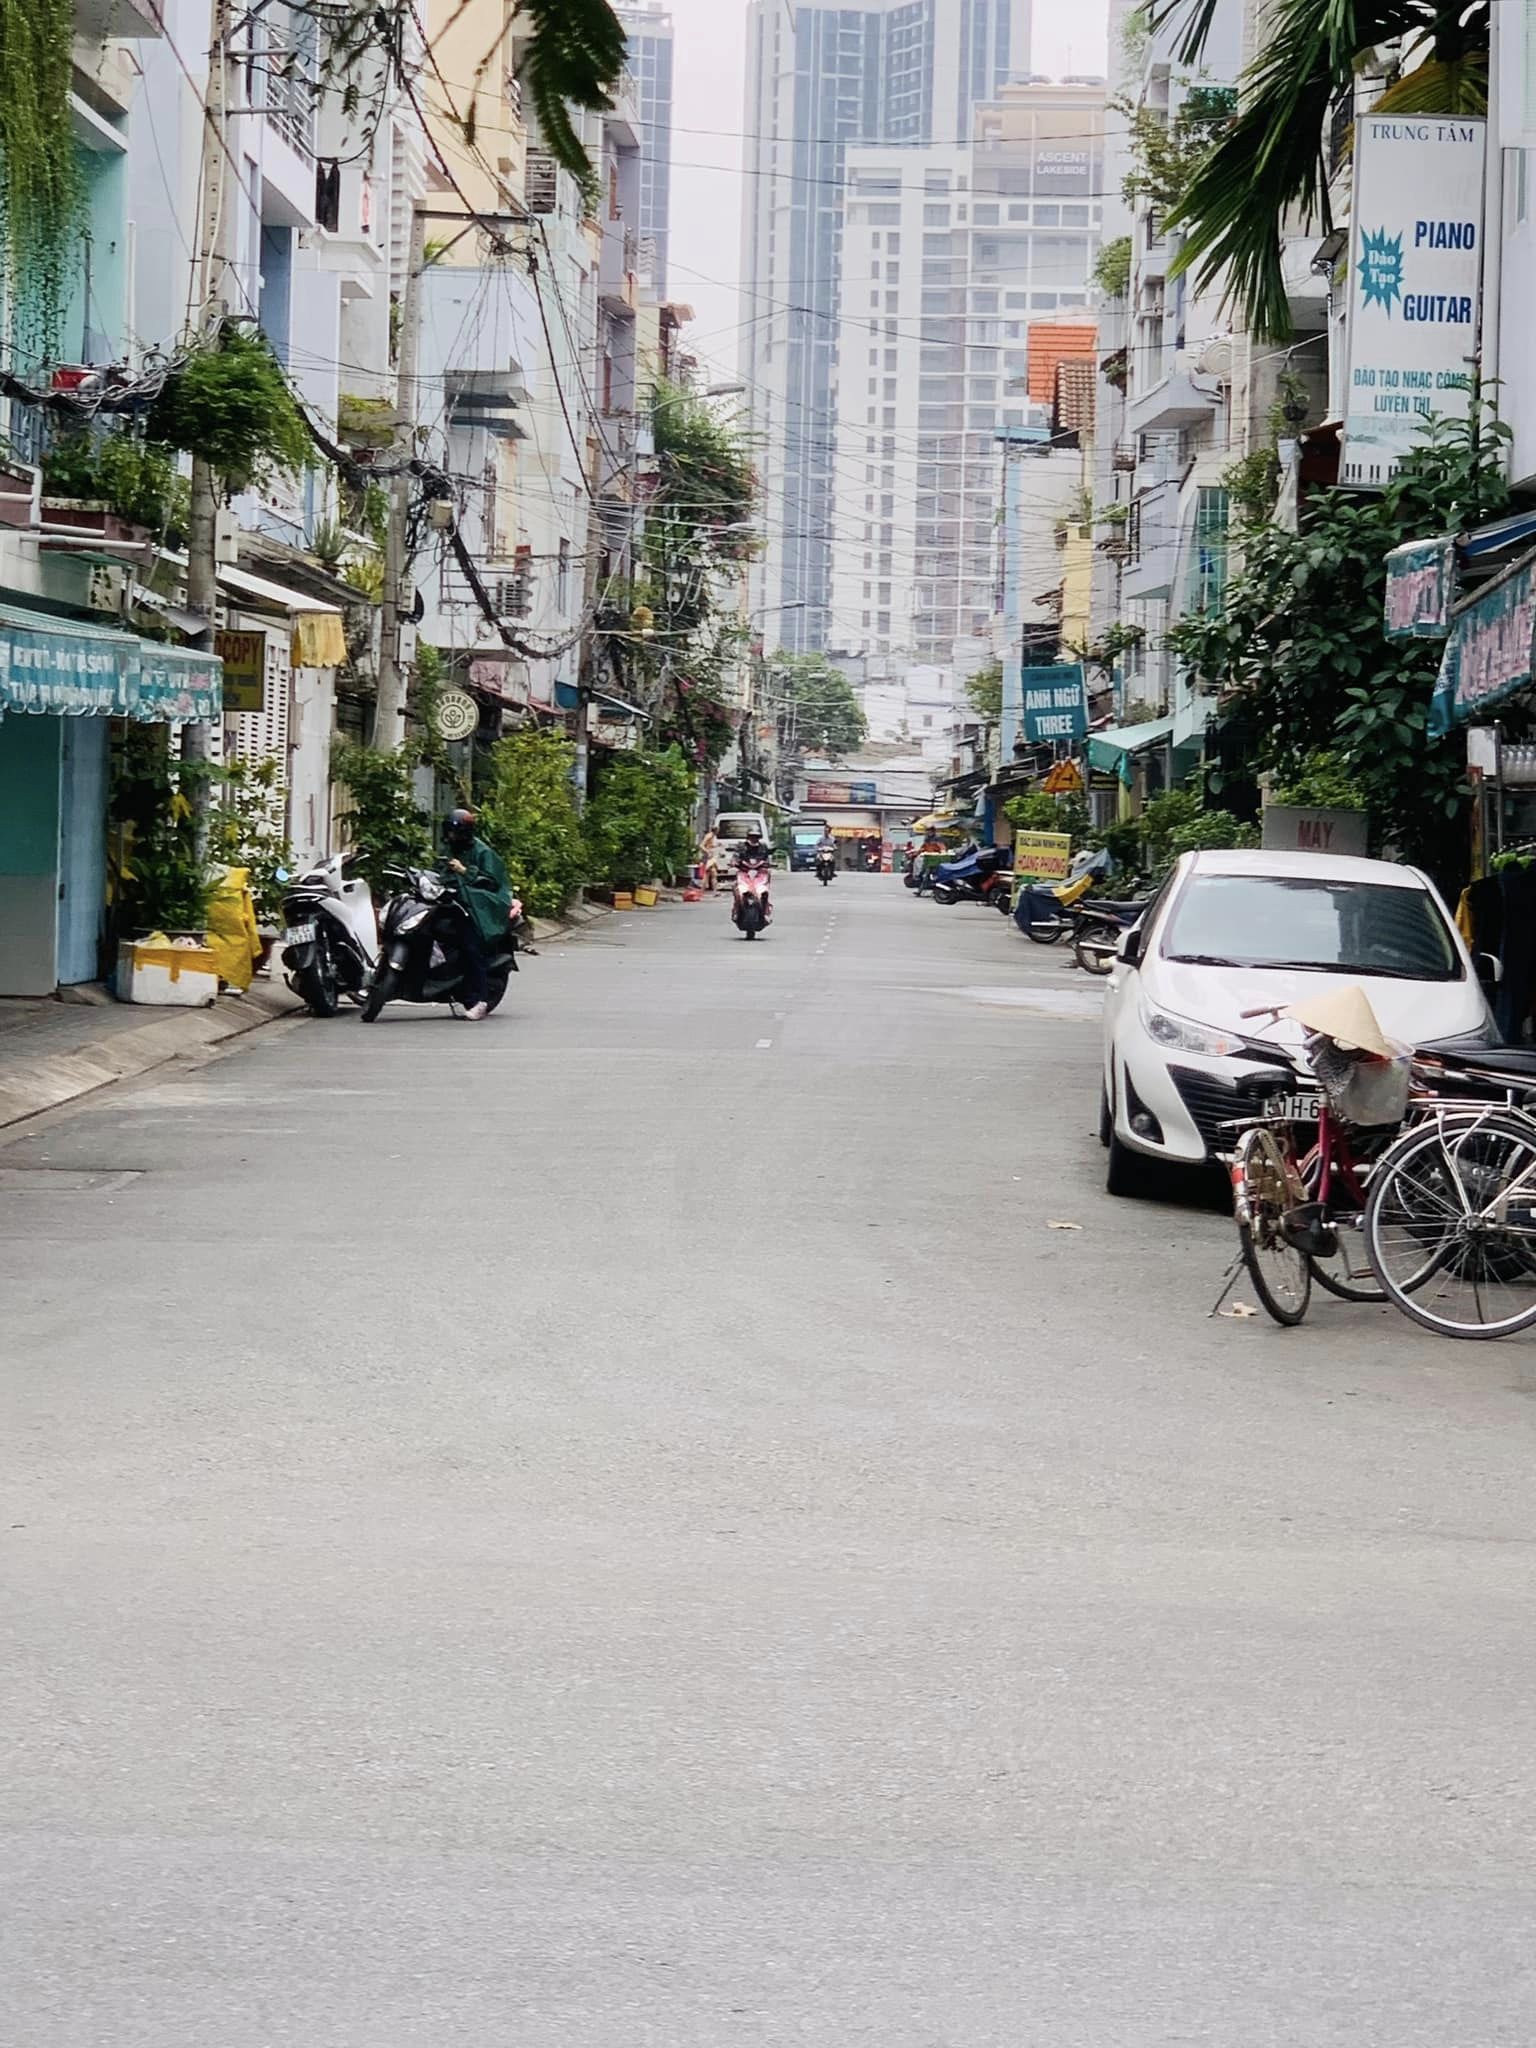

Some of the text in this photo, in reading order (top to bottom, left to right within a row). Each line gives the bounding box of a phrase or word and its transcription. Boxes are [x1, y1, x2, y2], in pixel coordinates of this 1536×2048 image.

[1371, 122, 1475, 143] TRUNG TÂM
[1039, 151, 1089, 162] ASCENT
[1036, 165, 1088, 176] LAKESIDE
[1414, 220, 1476, 250] PIANO
[1403, 294, 1472, 324] GUITAR
[1379, 369, 1400, 391] TẠO
[1402, 371, 1433, 393] NHẠC
[1025, 683, 1081, 710] ANH NGỮ
[1035, 714, 1074, 736] THREE
